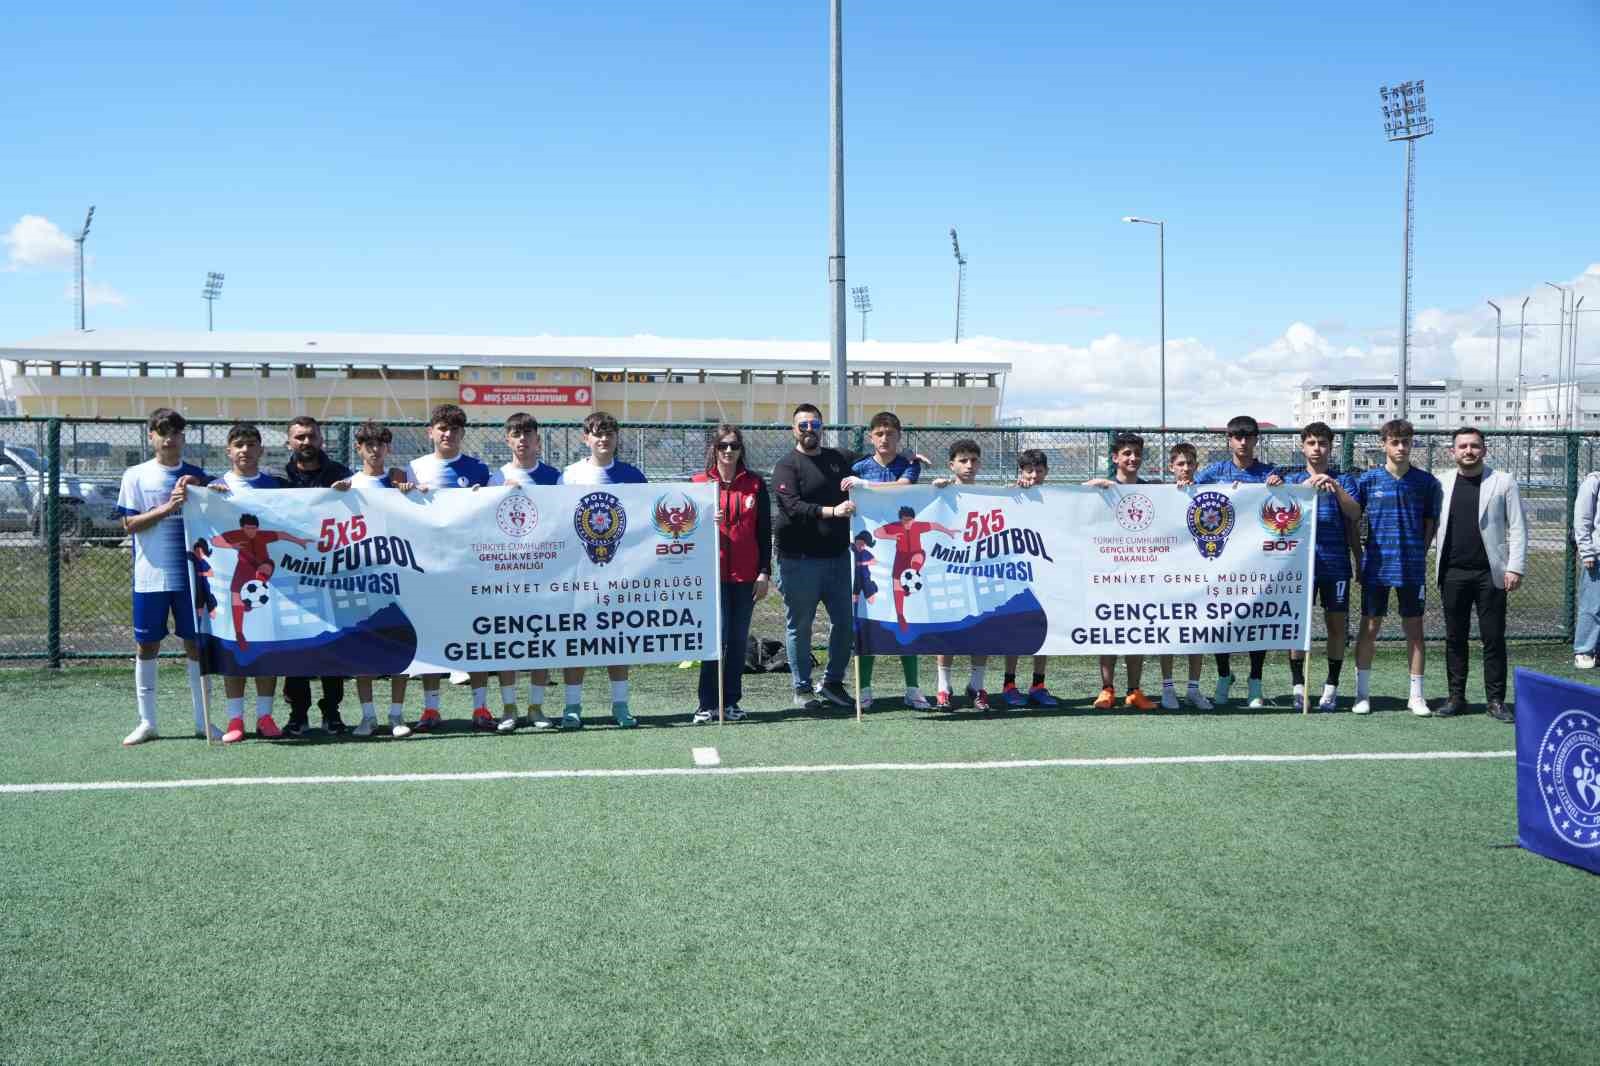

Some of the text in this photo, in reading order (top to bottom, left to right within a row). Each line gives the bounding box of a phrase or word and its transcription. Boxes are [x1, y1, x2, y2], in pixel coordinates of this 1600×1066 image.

[656, 540, 696, 555] BÖF
[975, 528, 1053, 562] FUTBOL
[1100, 544, 1135, 555] GENÇLİK
[1263, 537, 1298, 551] BÖF
[332, 536, 424, 575] FUTBOL
[479, 552, 557, 563] GENÇLİK VE SPOR
[1113, 553, 1157, 562] BAKANLIĞI
[494, 561, 544, 571] BAKANLIĞI
[471, 575, 703, 595] EMNİYET GENEL MÜDÜRLÜĞÜ
[1093, 571, 1303, 584] EMNİYET GENEL MÜDÜRLÜĞÜ
[1207, 584, 1303, 597] İŞ BİRLİĞİYLE
[1336, 580, 1346, 597] 17
[597, 590, 704, 607] İŞ BİRLİĞİYLE
[1095, 600, 1300, 625] GENÇLER SPORDA,
[472, 608, 702, 637] GENÇLER SPORDA,
[1071, 621, 1299, 644] GELECEK EMNİYETTE!
[444, 631, 703, 662] GELECEK EMNİYETTE!
